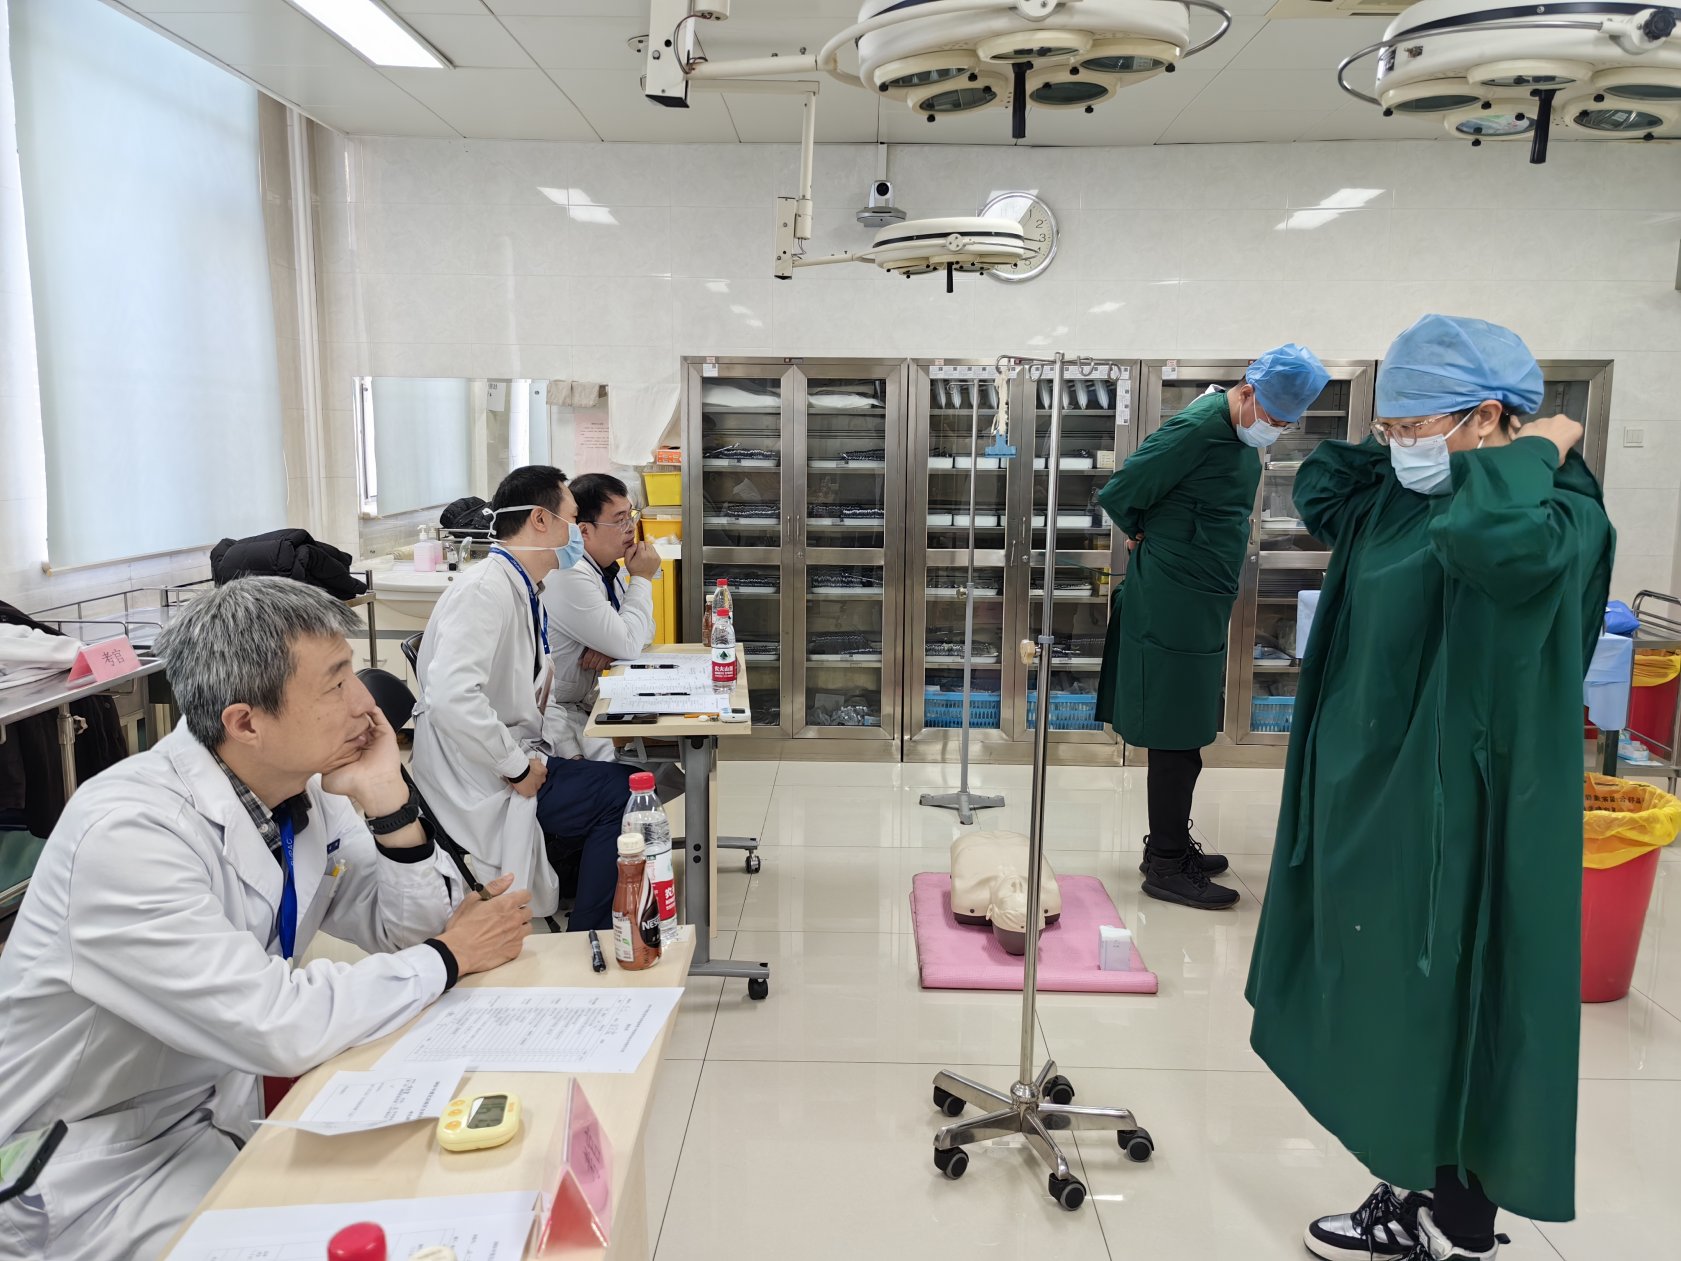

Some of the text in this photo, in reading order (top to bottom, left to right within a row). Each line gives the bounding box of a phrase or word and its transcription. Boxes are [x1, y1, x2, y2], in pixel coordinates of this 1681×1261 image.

[1035, 219, 1044, 229] 2
[1039, 233, 1047, 243] 3
[101, 648, 125, 667] 考官
